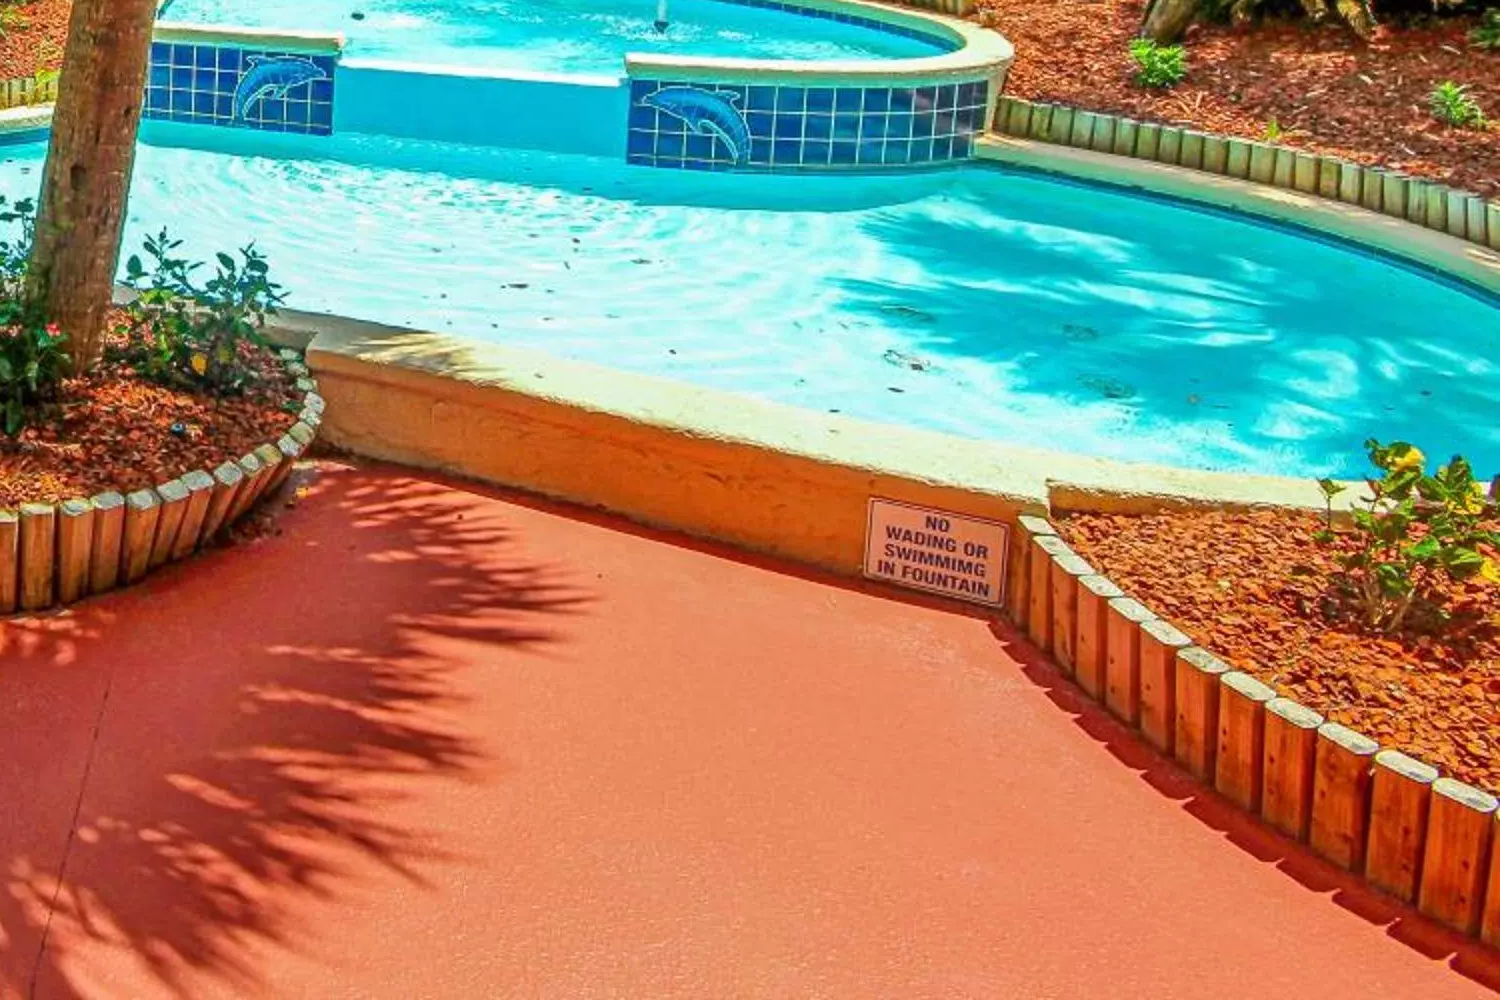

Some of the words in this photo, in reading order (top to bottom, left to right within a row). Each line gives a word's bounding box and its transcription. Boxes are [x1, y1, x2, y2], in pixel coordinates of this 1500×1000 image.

[925, 515, 950, 533] NO
[885, 525, 957, 553] WADING
[963, 541, 989, 559] OR
[877, 559, 895, 577] IN
[901, 565, 991, 598] FOUNTAIN
